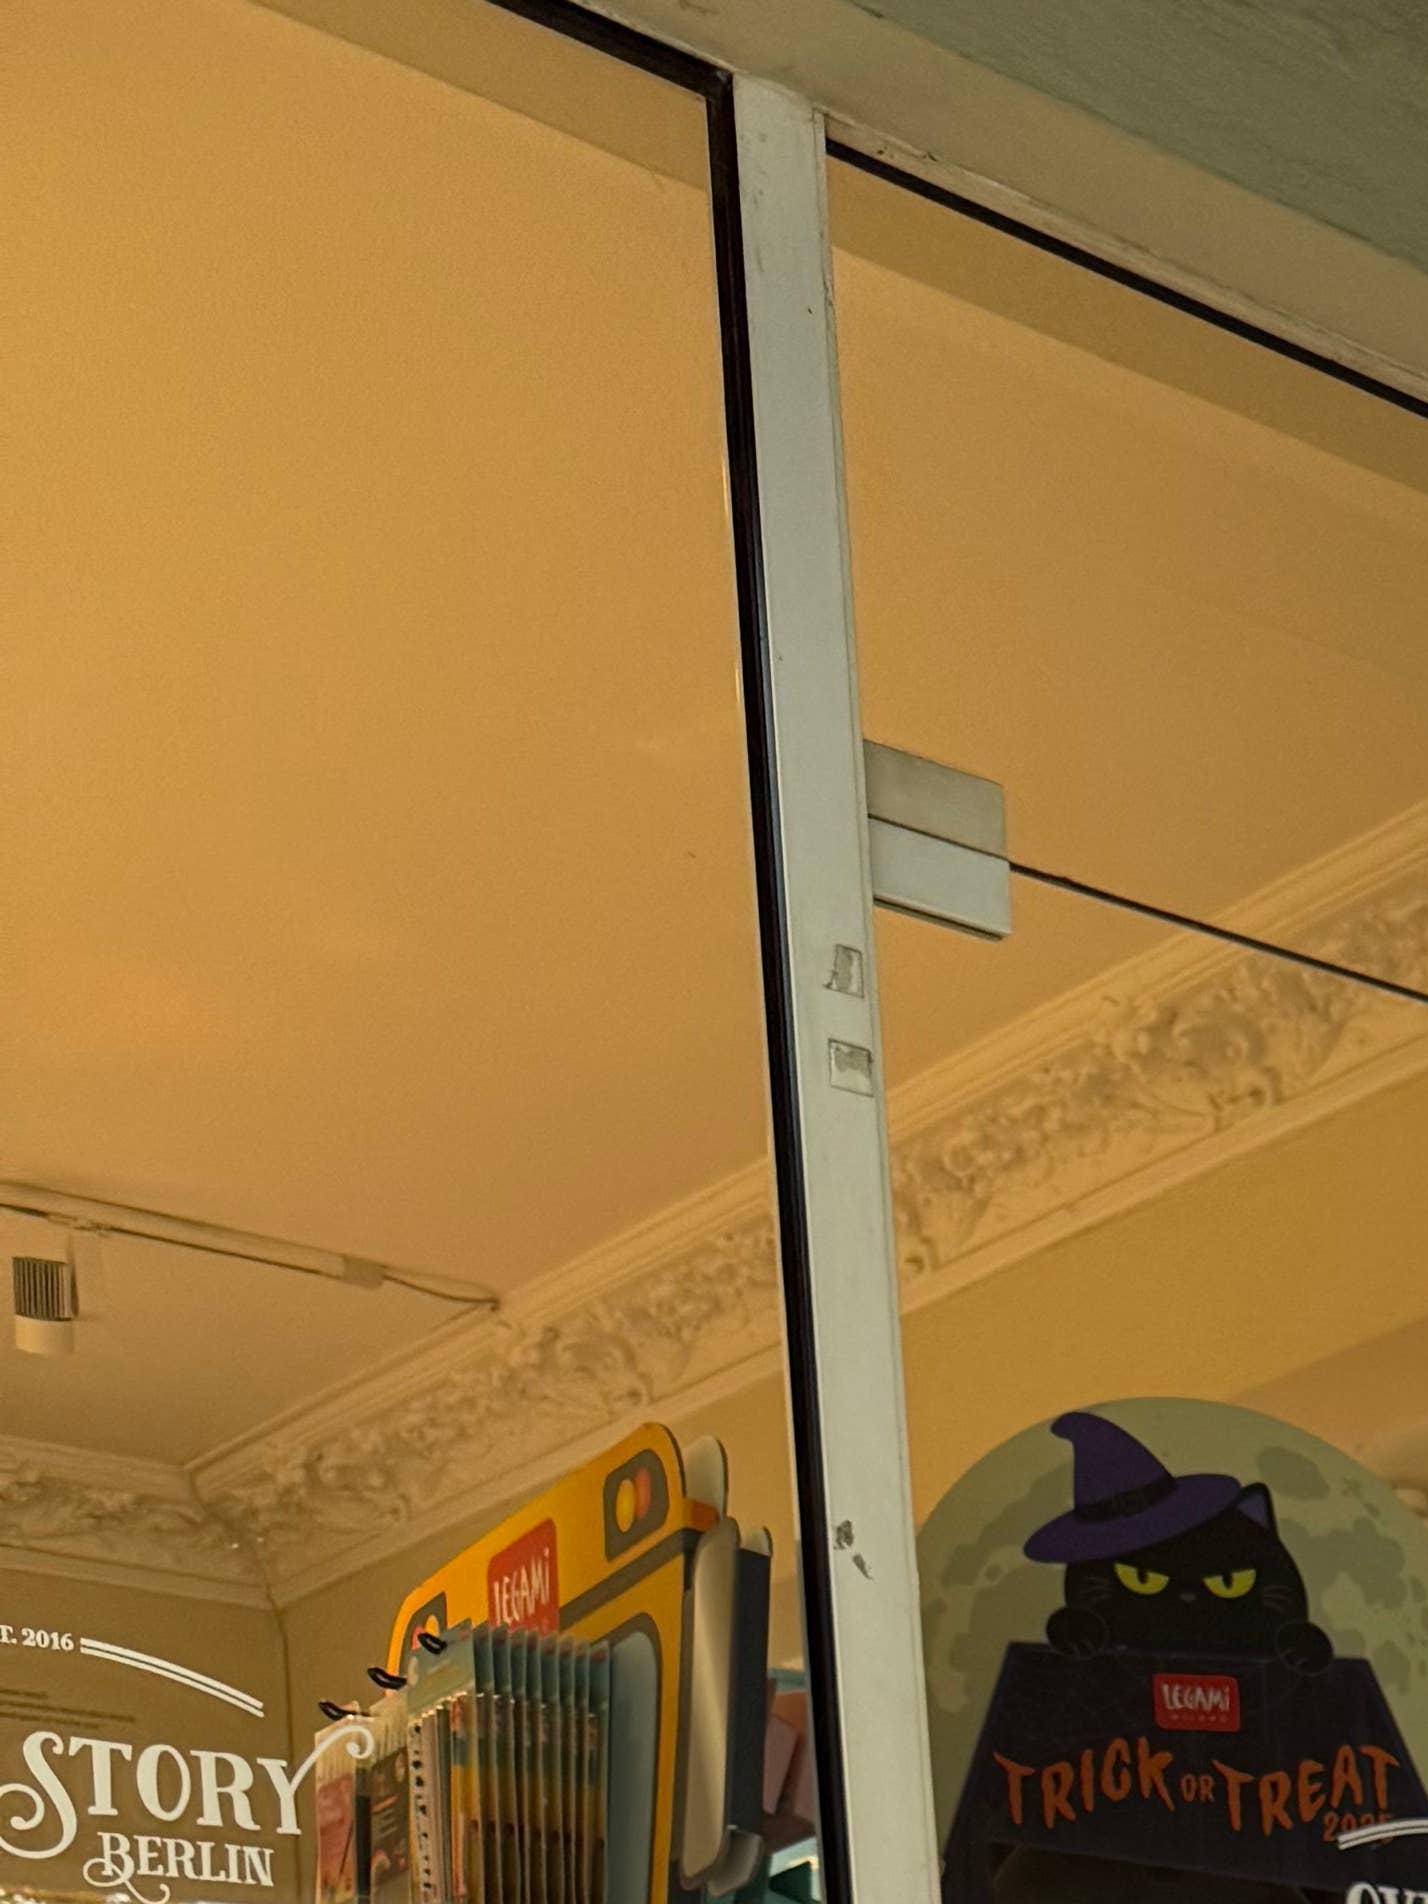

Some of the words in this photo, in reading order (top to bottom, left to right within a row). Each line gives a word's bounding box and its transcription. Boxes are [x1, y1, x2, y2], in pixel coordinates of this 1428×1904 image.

[22, 1627, 75, 1651] 2016
[0, 1724, 375, 1860] STORY
[993, 1736, 1174, 1830] TRICK
[1180, 1773, 1215, 1802] OR
[1212, 1744, 1399, 1837] TREAT
